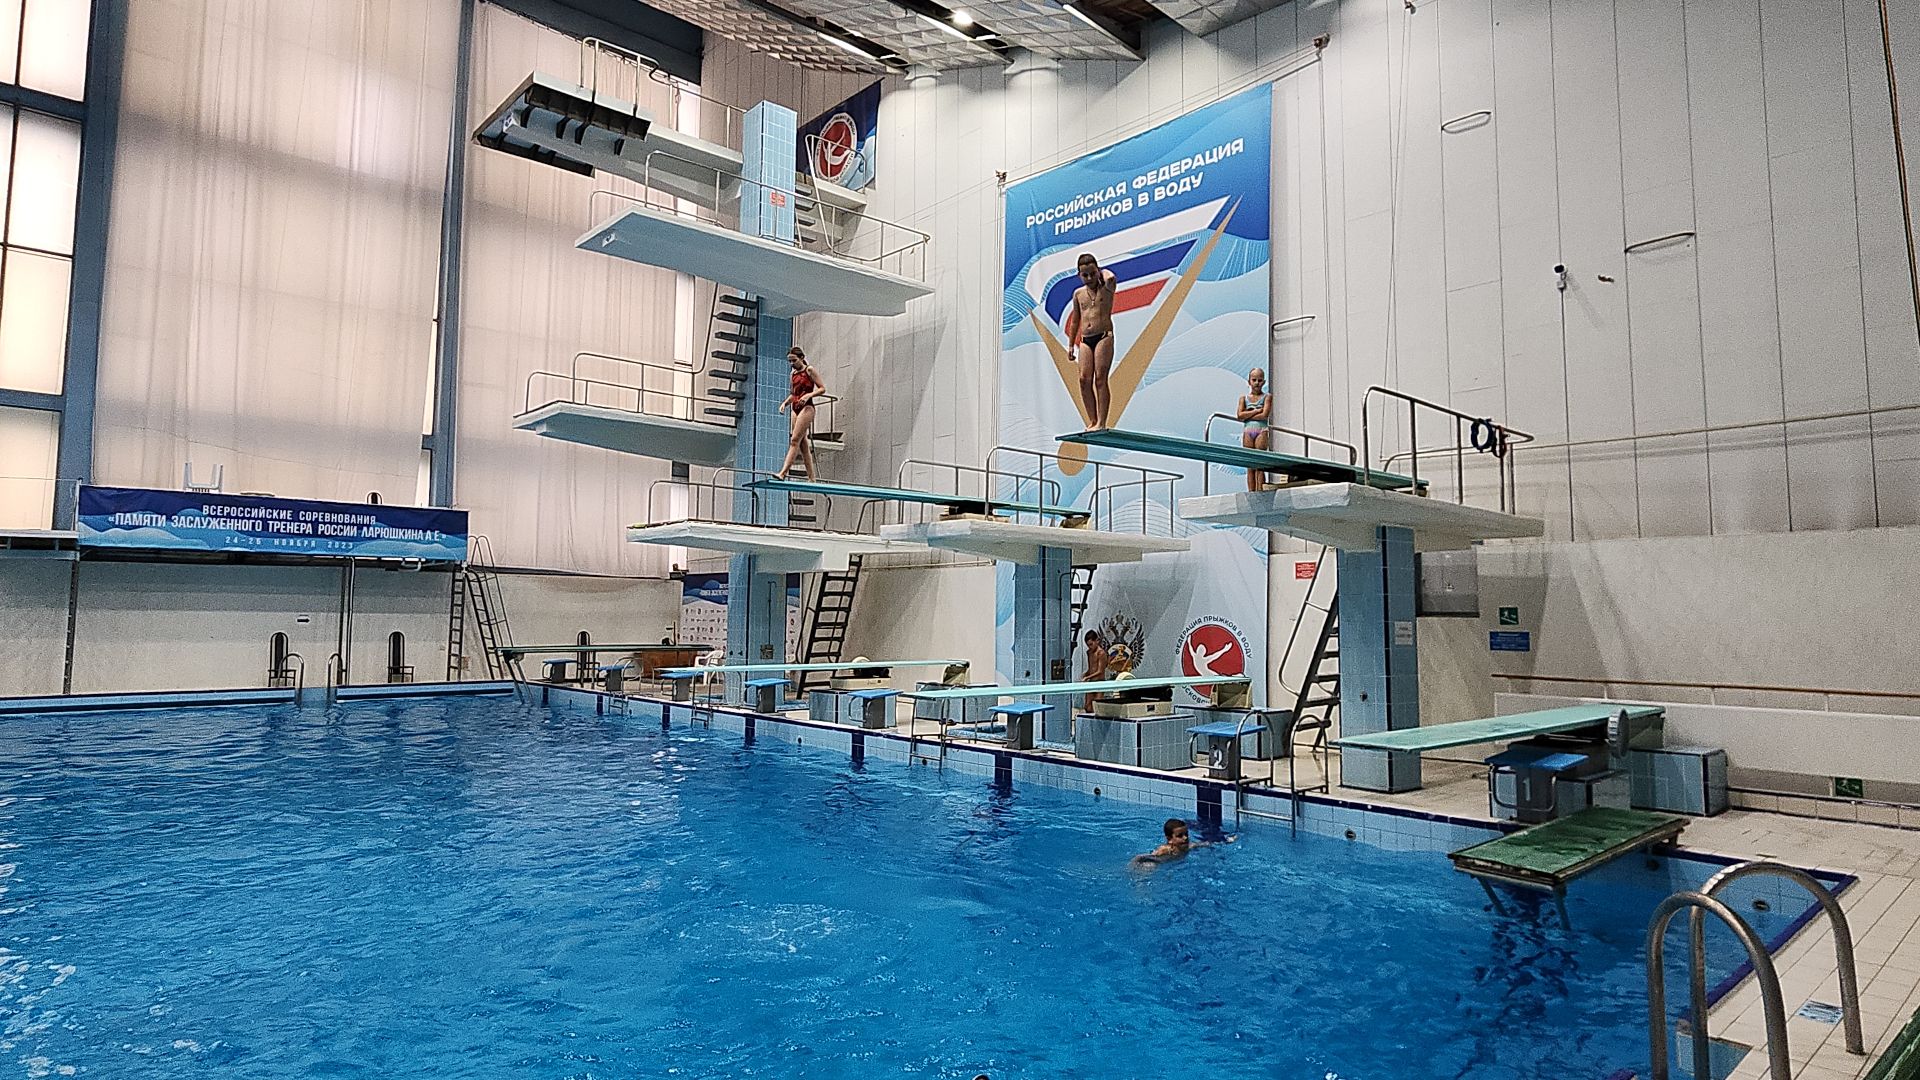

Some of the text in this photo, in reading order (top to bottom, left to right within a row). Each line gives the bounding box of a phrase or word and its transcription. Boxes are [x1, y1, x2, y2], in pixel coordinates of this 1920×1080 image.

[1026, 138, 1244, 228] РОССИЙСКАЯ ФЕДЕРАЦИЯ
[1055, 172, 1203, 235] ПРЫЖКОВ В ВОДУ
[108, 512, 166, 527] «ПАМЯТИ
[171, 515, 262, 532] ЗАСЛУЖЕННОГО
[267, 520, 313, 535] ТРЕНЕРА
[318, 523, 358, 537] РОССИИ
[361, 526, 424, 541] ЛАРЮШКИНА
[202, 504, 376, 525] ВСЕРОССИЙСКИЕ СОРЕВНОВАНИЯ
[274, 538, 316, 548] НОЯБРЯ
[1175, 617, 1202, 655] ФЕДЕРАЦИЯ
[1203, 615, 1238, 632] ПРЫЖКОВ
[1241, 636, 1253, 659] ВОДУ
[1523, 777, 1531, 801] 1
